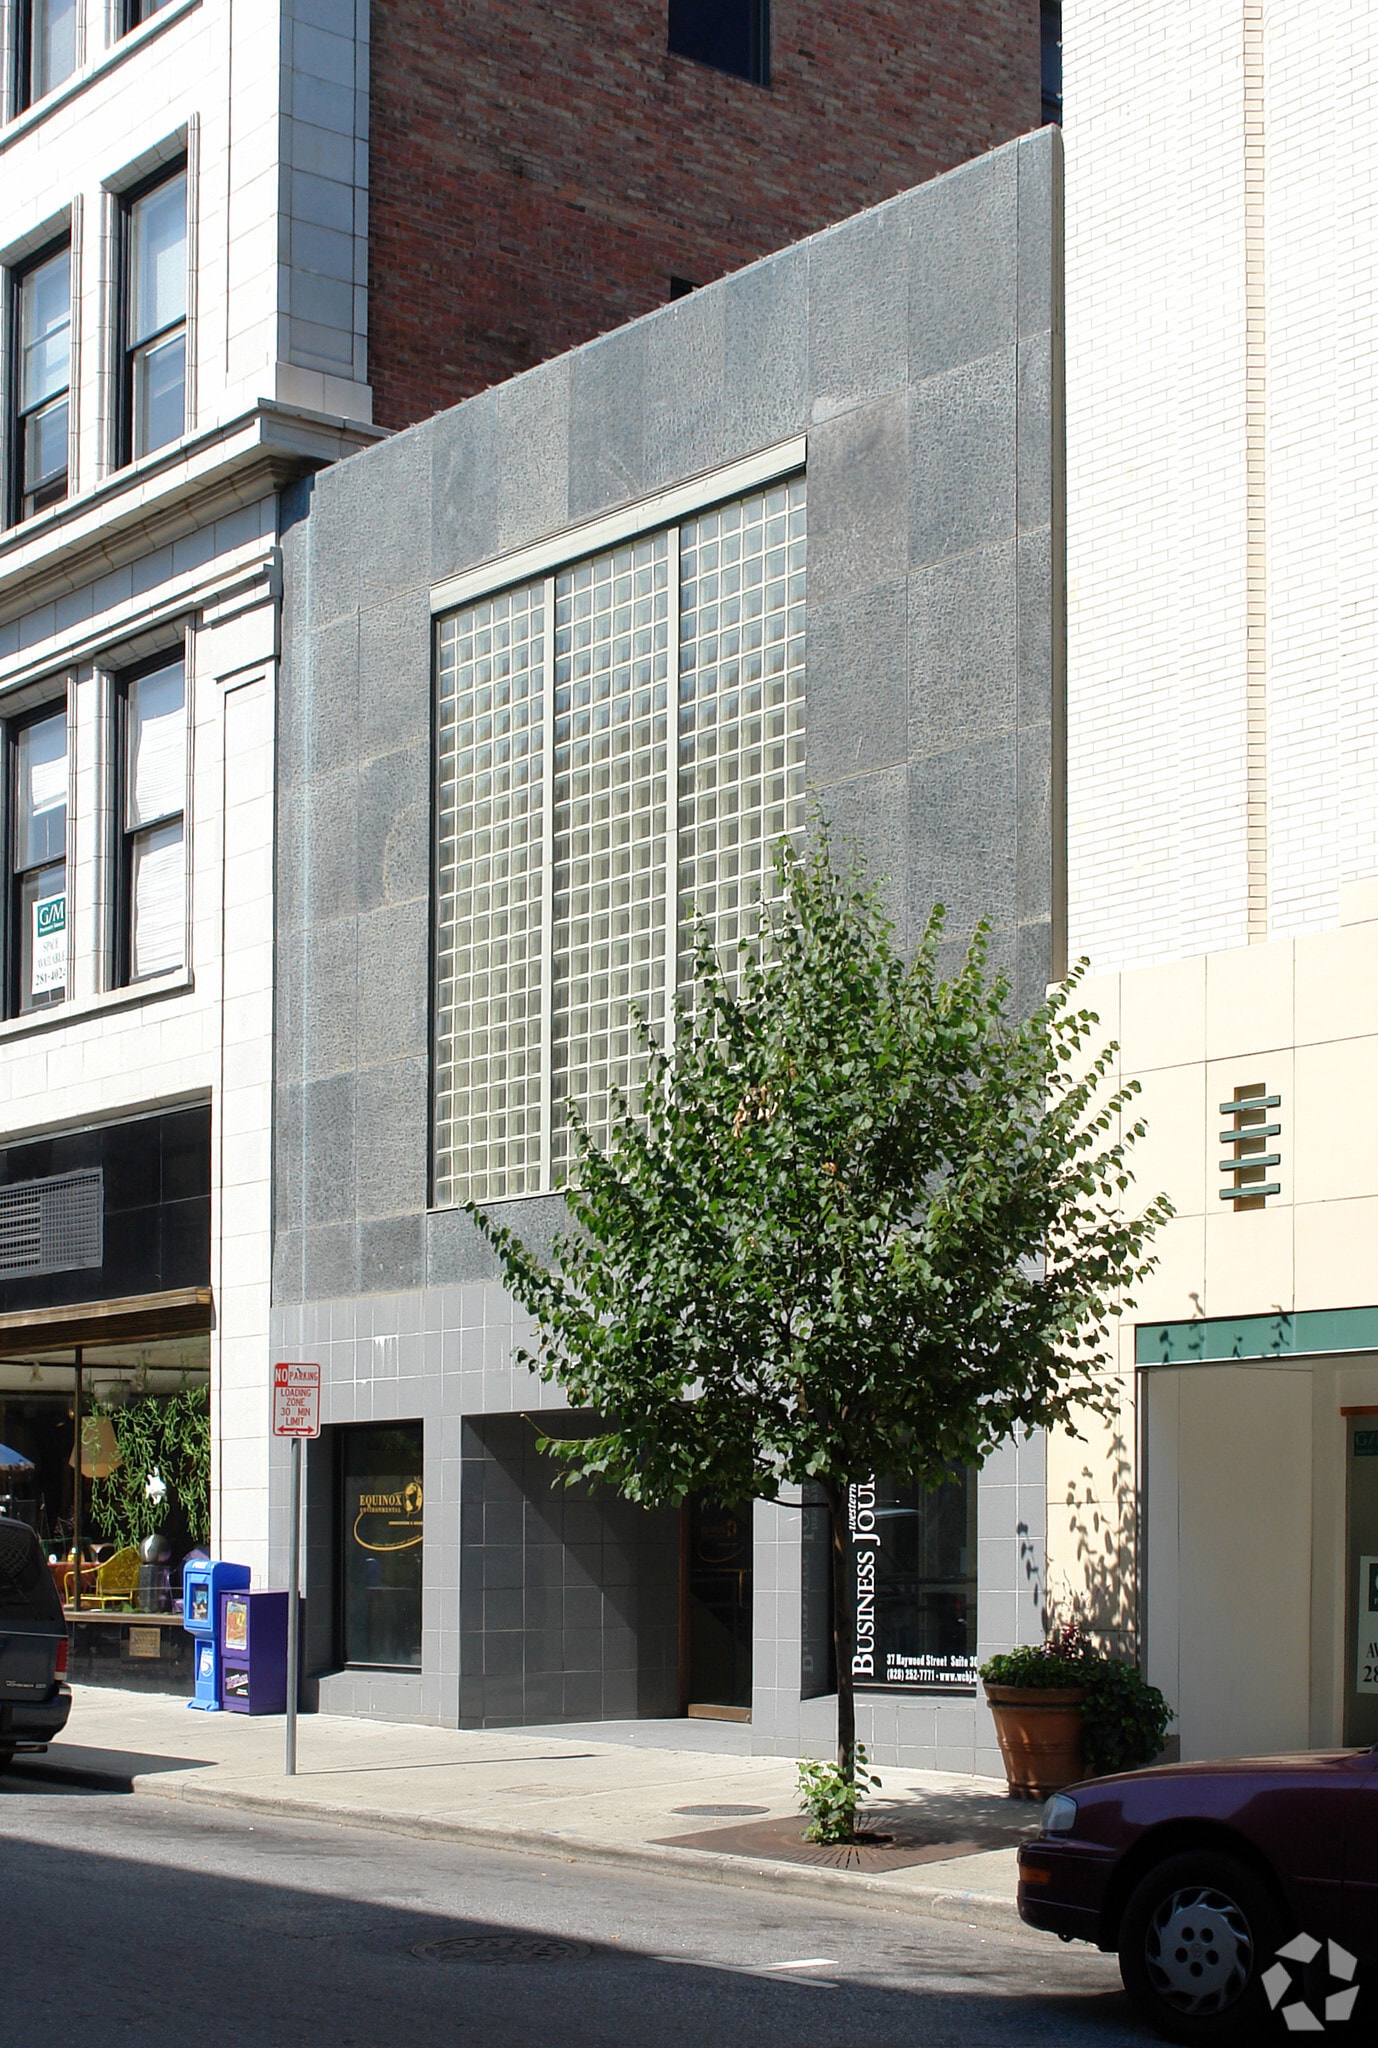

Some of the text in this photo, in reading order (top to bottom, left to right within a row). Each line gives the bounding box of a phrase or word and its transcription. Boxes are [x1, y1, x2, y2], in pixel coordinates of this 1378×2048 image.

[43, 938, 59, 952] SPACE
[37, 951, 66, 968] AVAILABLE
[275, 1368, 318, 1382] NO PARKING
[280, 1388, 311, 1397] LOADING
[286, 1398, 305, 1406] ZONE
[280, 1407, 311, 1416] 30 MIN
[286, 1417, 304, 1426] LIMIT
[359, 1494, 402, 1508] EQUINOX
[848, 1483, 857, 1531] western
[851, 1551, 876, 1677] BUSINESS
[886, 1653, 895, 1666] 37
[896, 1653, 925, 1668] Haywood
[926, 1654, 947, 1667] Street
[951, 1655, 968, 1668] Suite
[886, 1667, 904, 1682] (828)
[905, 1668, 935, 1681] 252-7771
